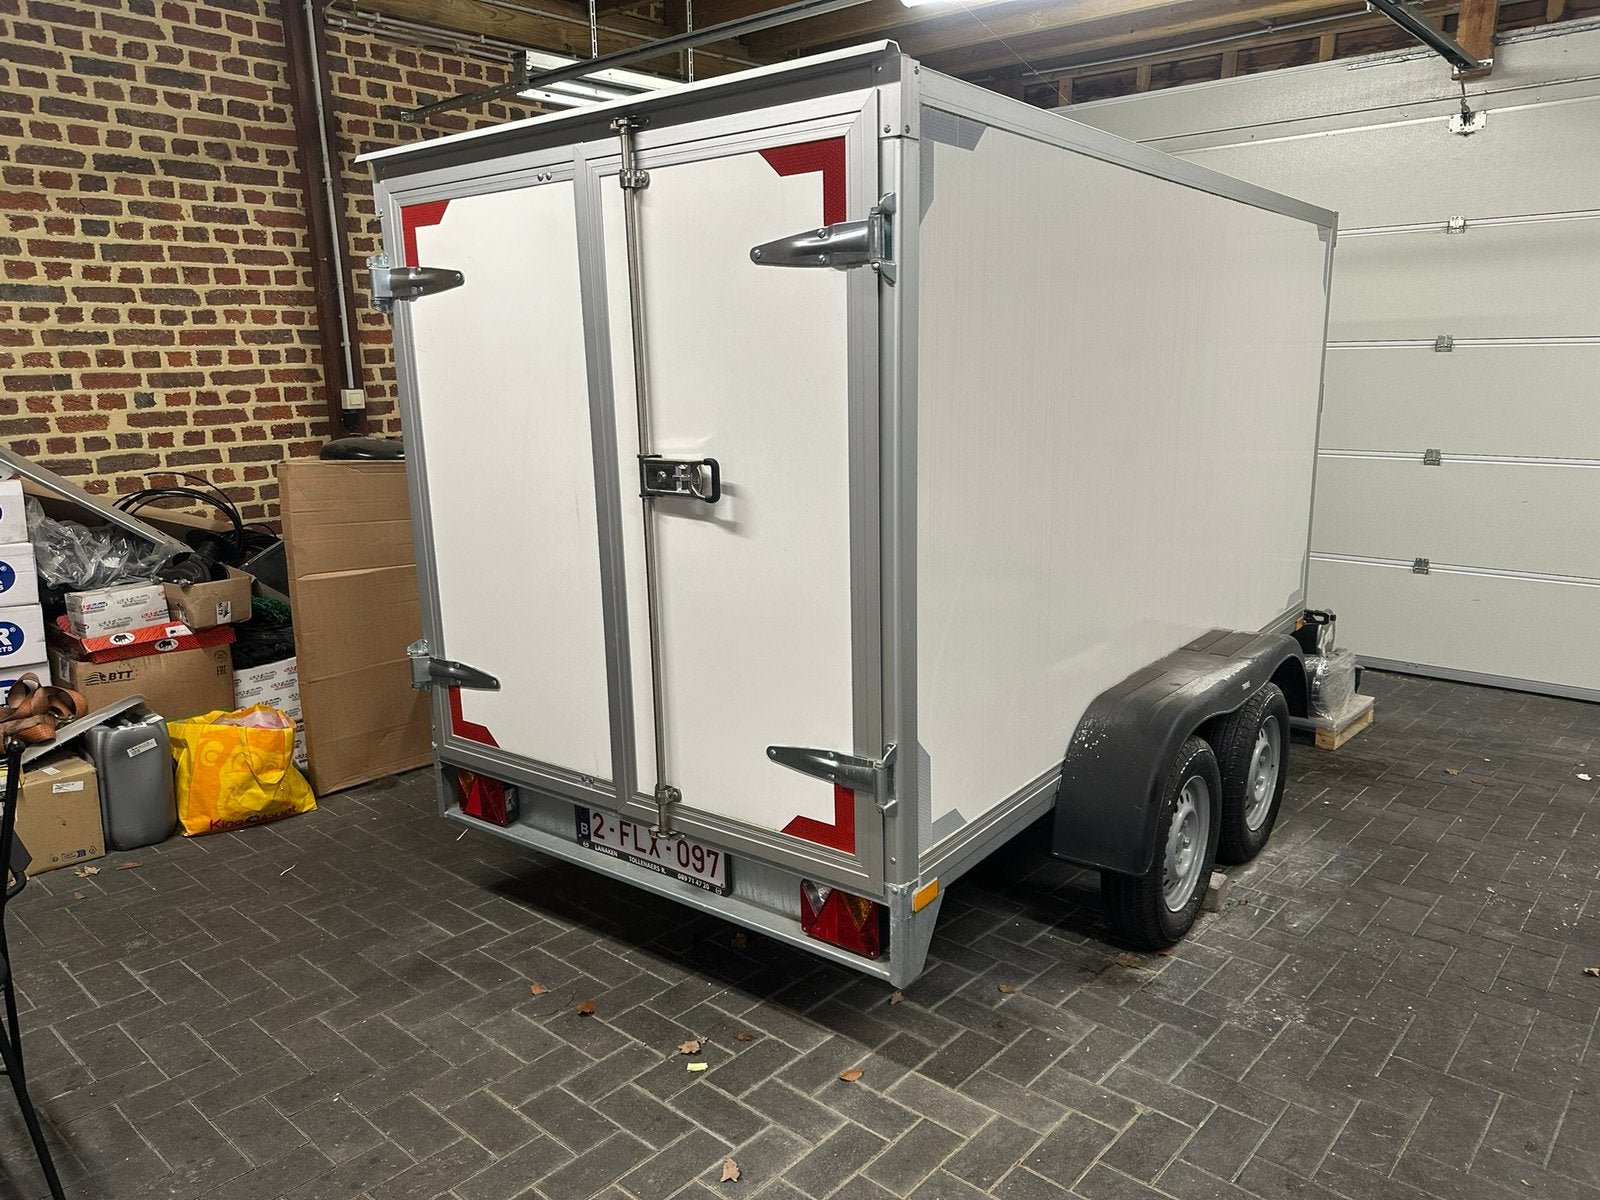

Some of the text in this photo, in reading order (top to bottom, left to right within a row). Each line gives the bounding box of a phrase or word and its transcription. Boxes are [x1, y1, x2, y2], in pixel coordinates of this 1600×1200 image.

[108, 670, 133, 681] BTT
[580, 822, 589, 835] B
[594, 845, 618, 857] LANAKEN
[628, 856, 661, 872] TOLLENAERS
